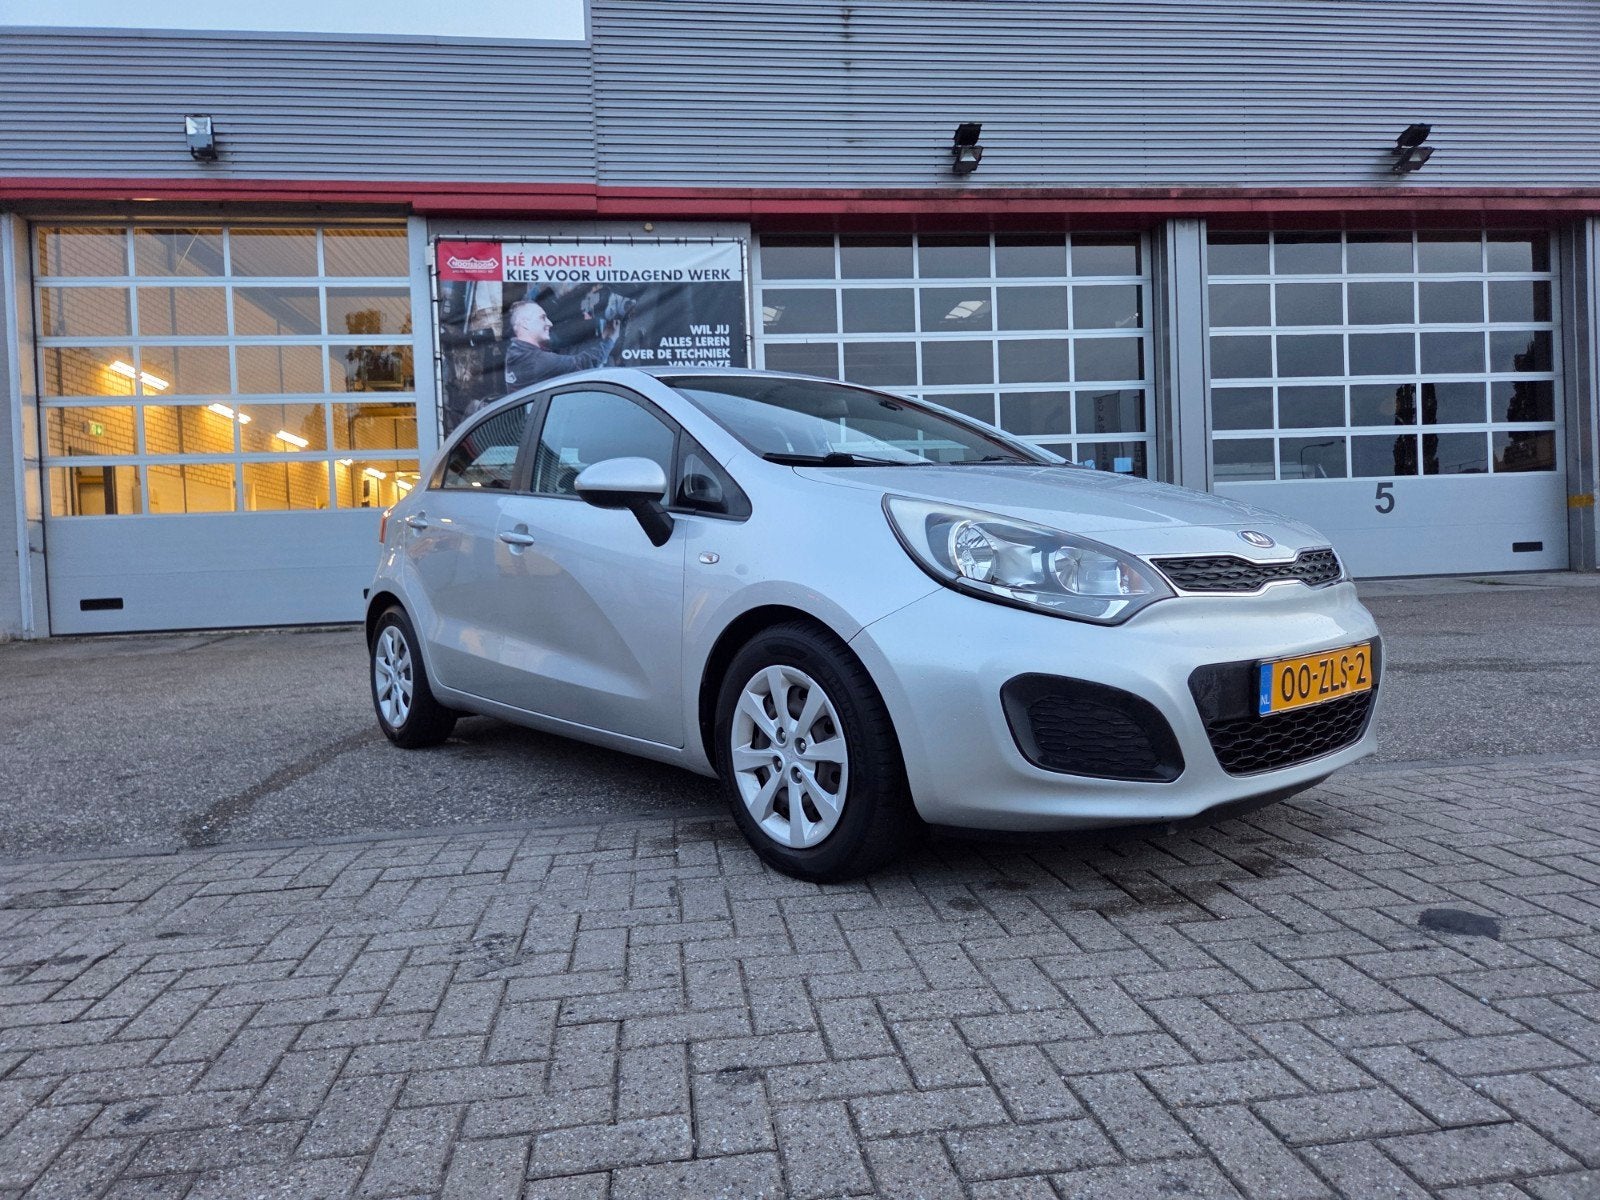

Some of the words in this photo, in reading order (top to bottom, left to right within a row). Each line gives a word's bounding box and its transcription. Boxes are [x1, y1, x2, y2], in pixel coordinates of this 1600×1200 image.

[506, 252, 525, 267] HÉ
[531, 254, 612, 267] MONTEUR!
[507, 269, 539, 281] KIES
[544, 269, 590, 281] VOOR
[596, 269, 683, 281] UITDAGEND
[688, 269, 730, 280] WERK
[690, 324, 712, 335] WIL
[715, 324, 729, 335] JIJ
[660, 337, 692, 347] ALLES
[696, 336, 730, 346] LEREN
[622, 349, 654, 360] OVER
[658, 349, 672, 359] DE
[675, 348, 731, 359] TECHNIEK
[1375, 482, 1395, 514] 5
[1260, 694, 1270, 705] NL
[1281, 650, 1366, 702] 00-ZLS-2
